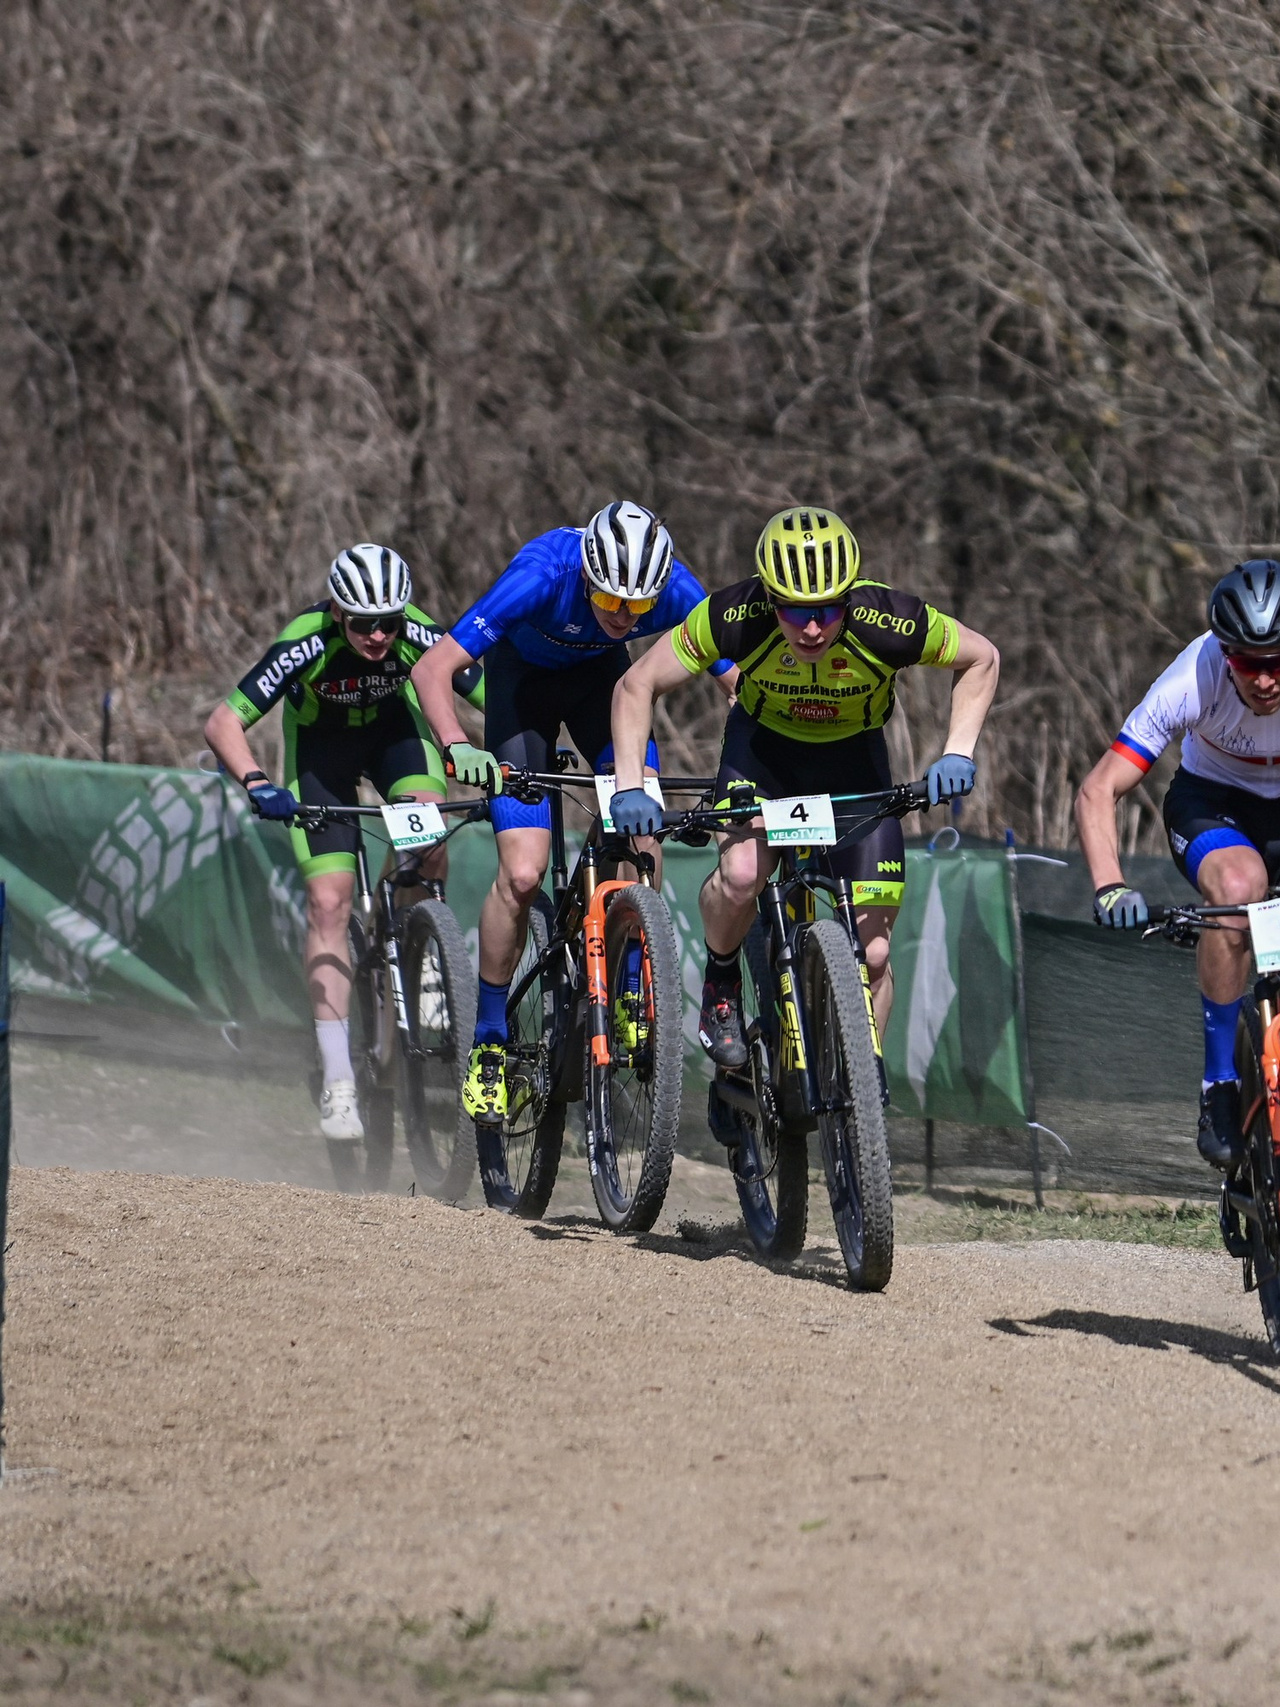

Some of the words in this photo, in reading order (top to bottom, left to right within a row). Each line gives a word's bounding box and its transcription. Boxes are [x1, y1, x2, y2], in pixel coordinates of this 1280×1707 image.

[852, 605, 916, 637] ФВСЧО
[256, 634, 325, 699] RUSSIA
[758, 678, 872, 698] ЧЕЛЯБИНСКАЯ
[790, 803, 809, 822] 4
[407, 813, 424, 833] 8
